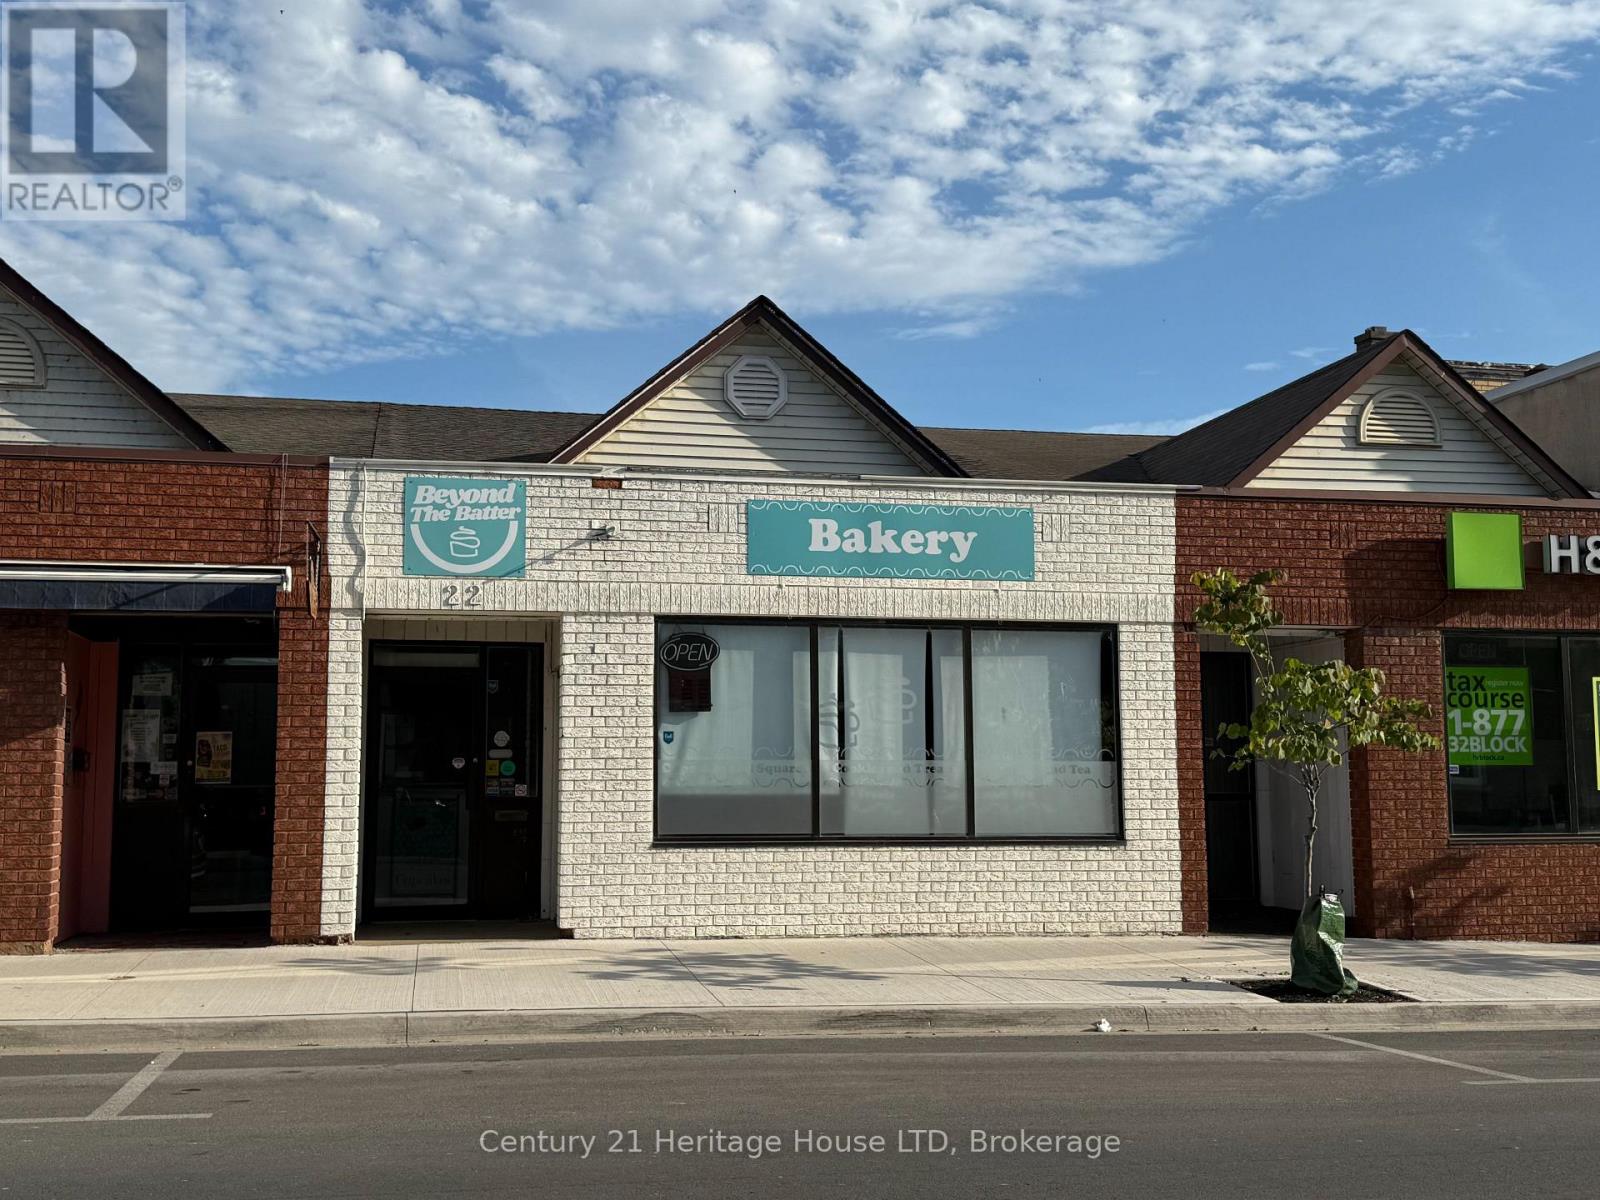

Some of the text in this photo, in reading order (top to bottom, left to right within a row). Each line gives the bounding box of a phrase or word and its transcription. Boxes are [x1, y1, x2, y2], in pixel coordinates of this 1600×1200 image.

[413, 483, 516, 509] Beyond
[410, 505, 522, 522] The Batter
[808, 518, 978, 563] Bakery
[442, 584, 483, 608] 22
[663, 643, 714, 661] OPEN
[1446, 671, 1487, 692] tax
[1447, 691, 1525, 708] course
[1447, 708, 1526, 736] 1-877
[1449, 736, 1528, 753] 32BLOCK
[1069, 765, 1091, 774] Tea
